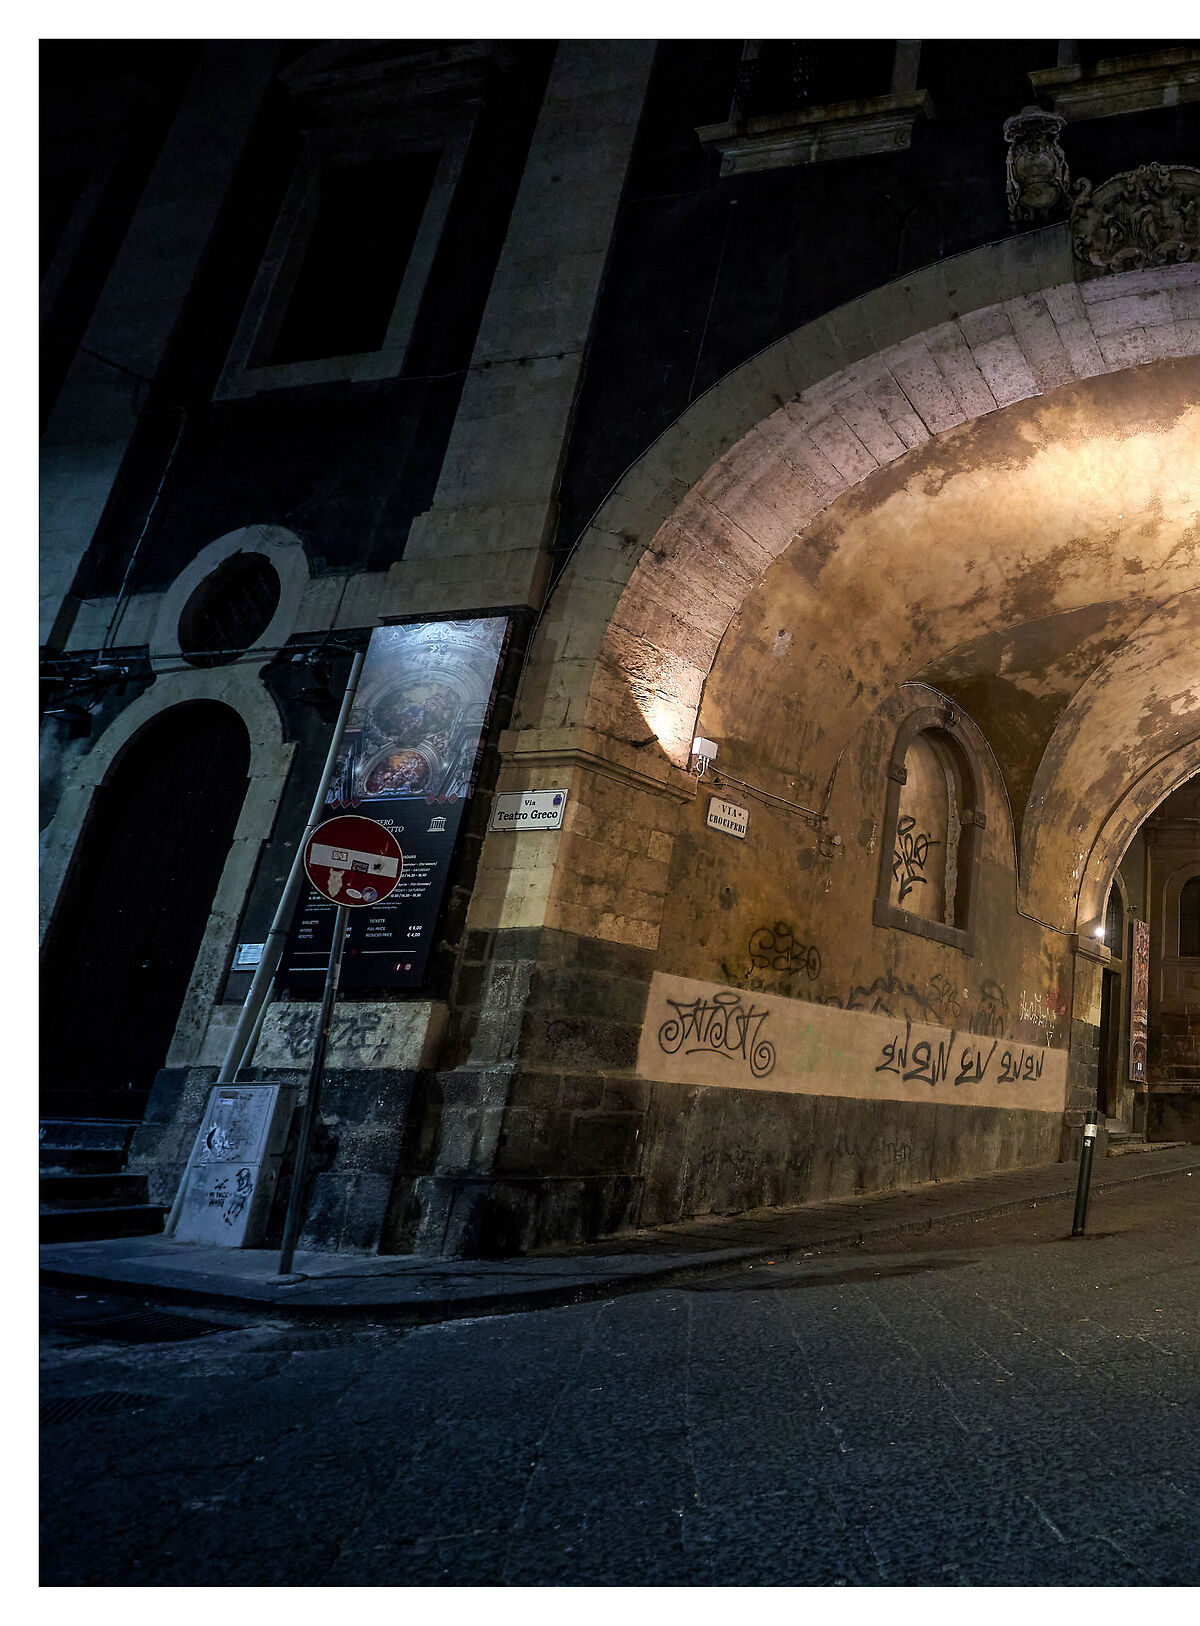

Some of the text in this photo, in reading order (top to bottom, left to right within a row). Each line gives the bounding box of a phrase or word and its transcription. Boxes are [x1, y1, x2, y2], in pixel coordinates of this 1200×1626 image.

[497, 809, 558, 821] Teatro Greco
[722, 804, 737, 818] VIA
[709, 813, 746, 834] CROCIFERI
